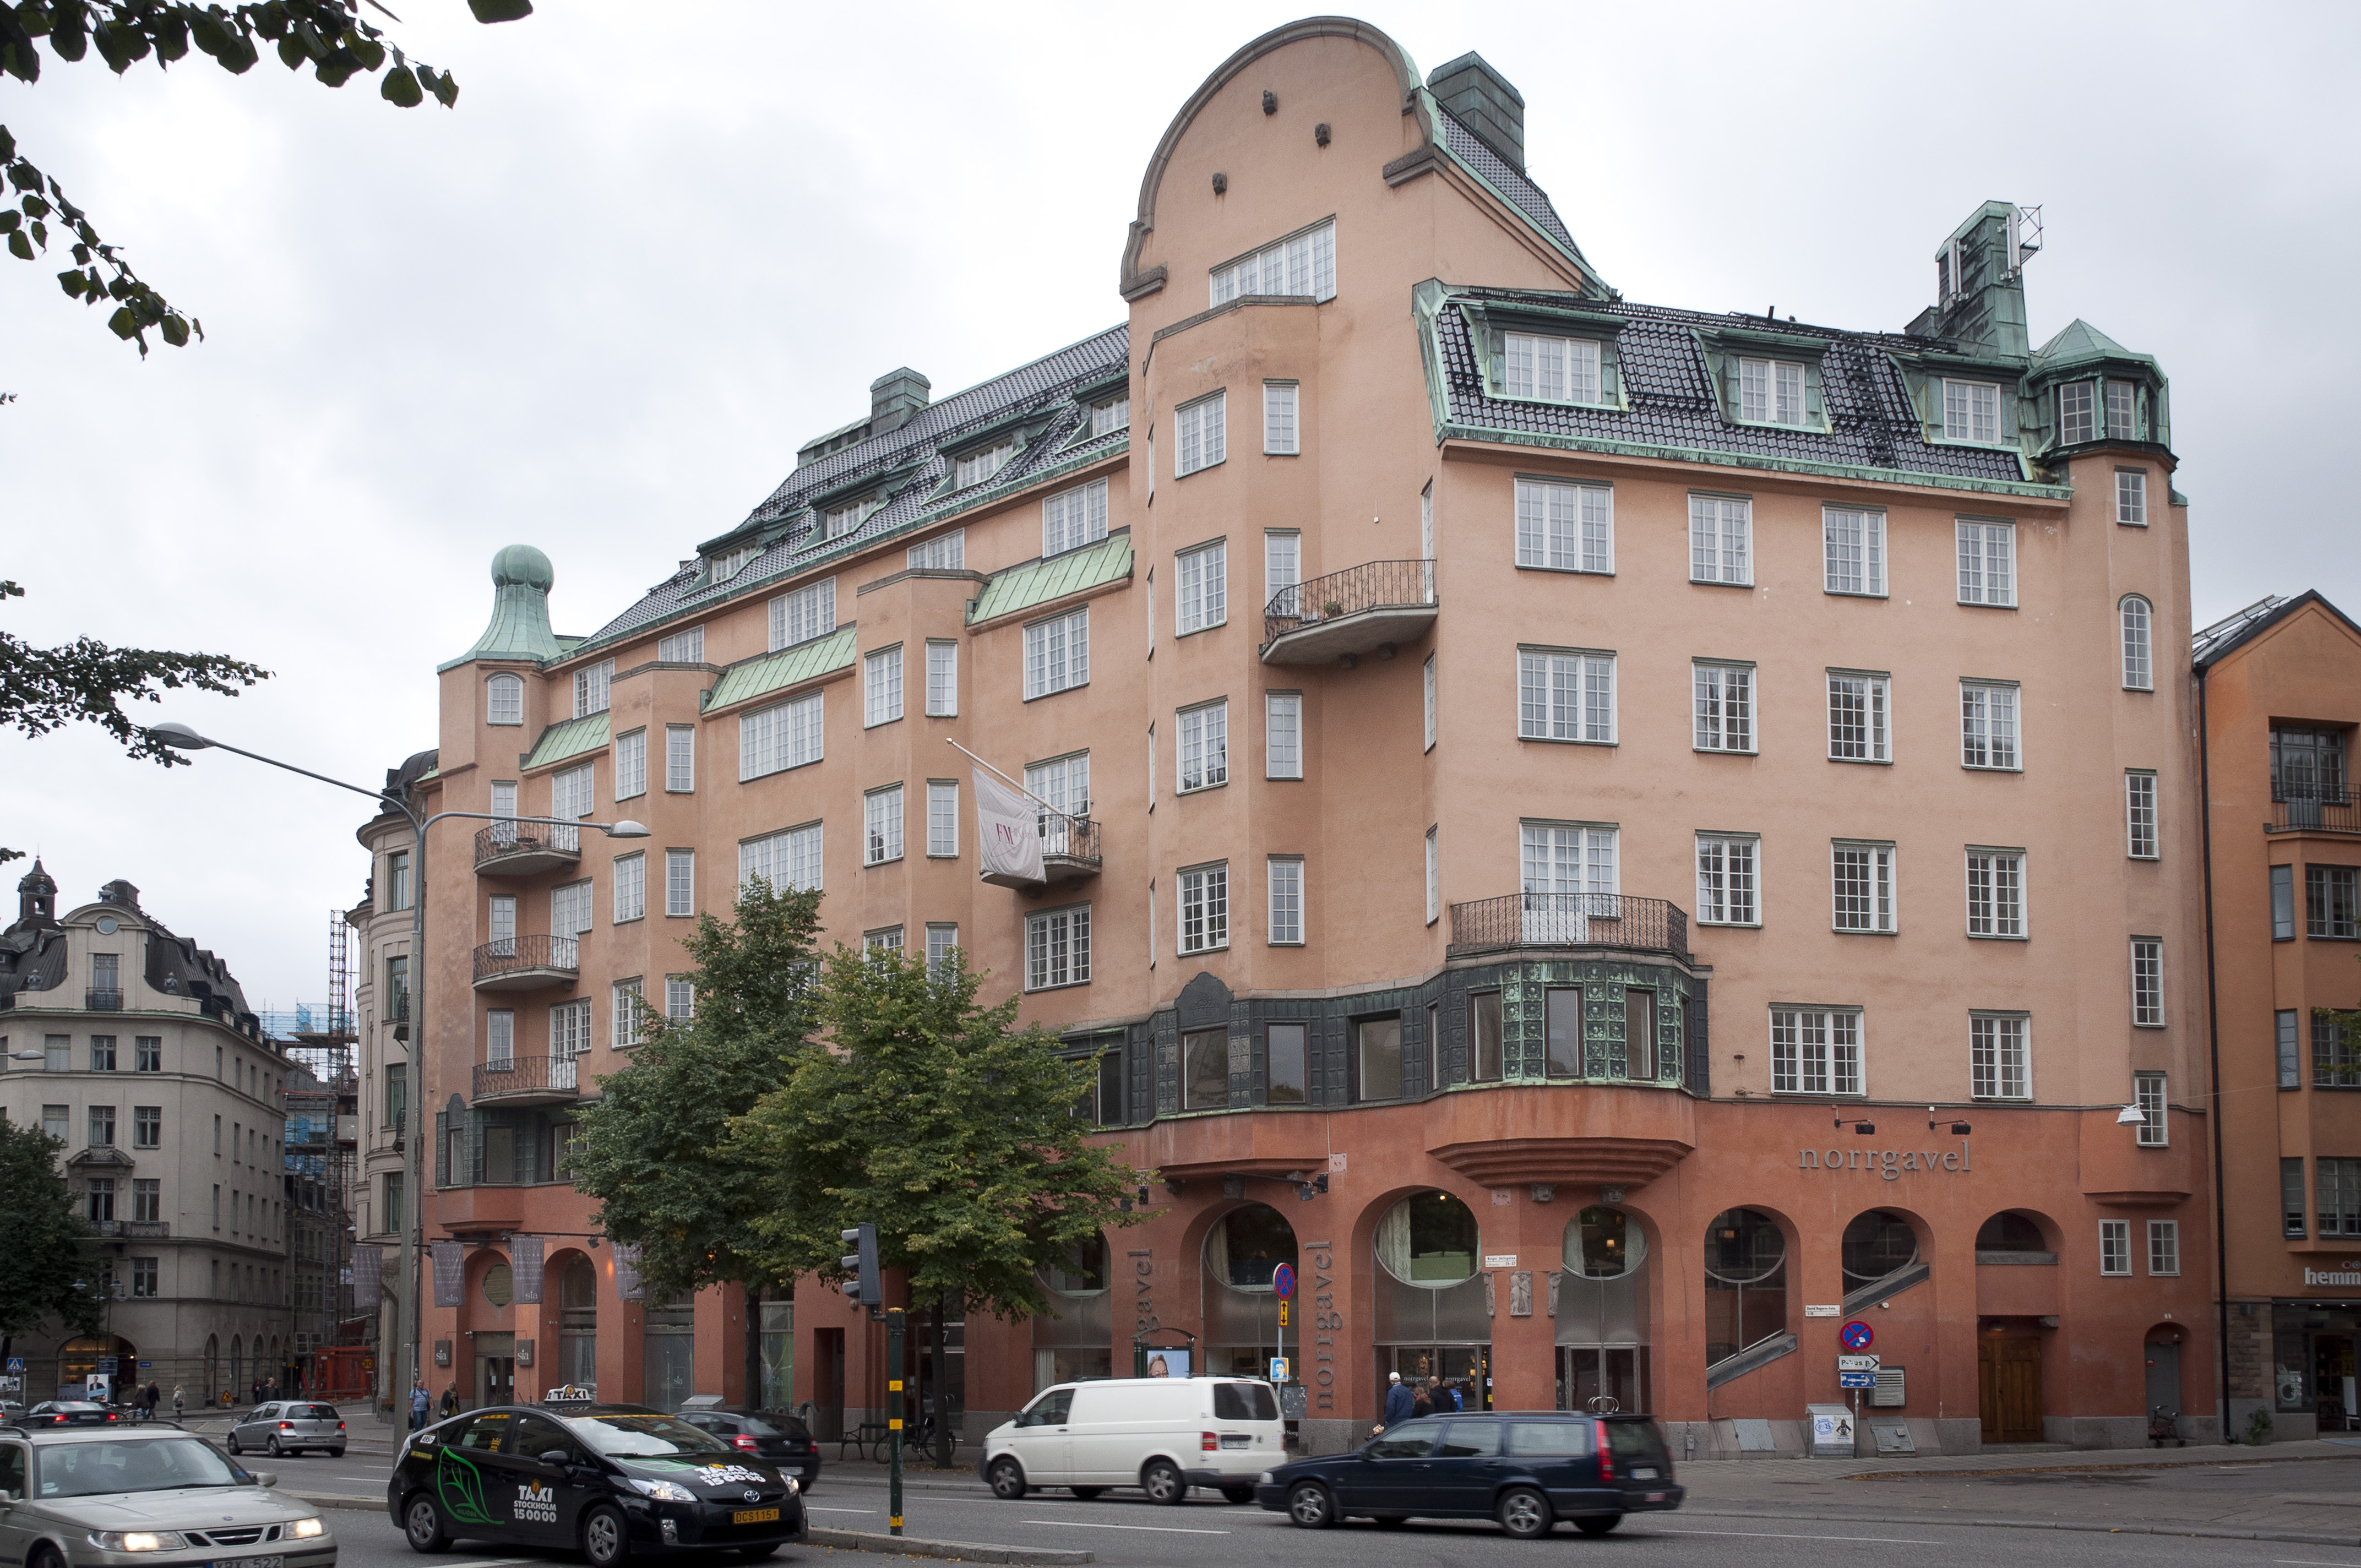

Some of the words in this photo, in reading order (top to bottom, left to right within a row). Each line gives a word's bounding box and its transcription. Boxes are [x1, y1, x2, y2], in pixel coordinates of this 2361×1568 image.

[1799, 1139, 1971, 1180] norrgavel
[525, 1291, 538, 1299] sia
[1304, 1241, 1342, 1409] norrgavel
[436, 1349, 447, 1360] sia
[517, 1349, 529, 1360] sia
[673, 1375, 683, 1384] sia
[554, 1391, 586, 1399] TAXI
[694, 1465, 748, 1475] TAXI
[699, 1471, 760, 1480] STOCKHOLM
[518, 1485, 553, 1502] TAXI
[514, 1500, 557, 1511] STOCKHOLM
